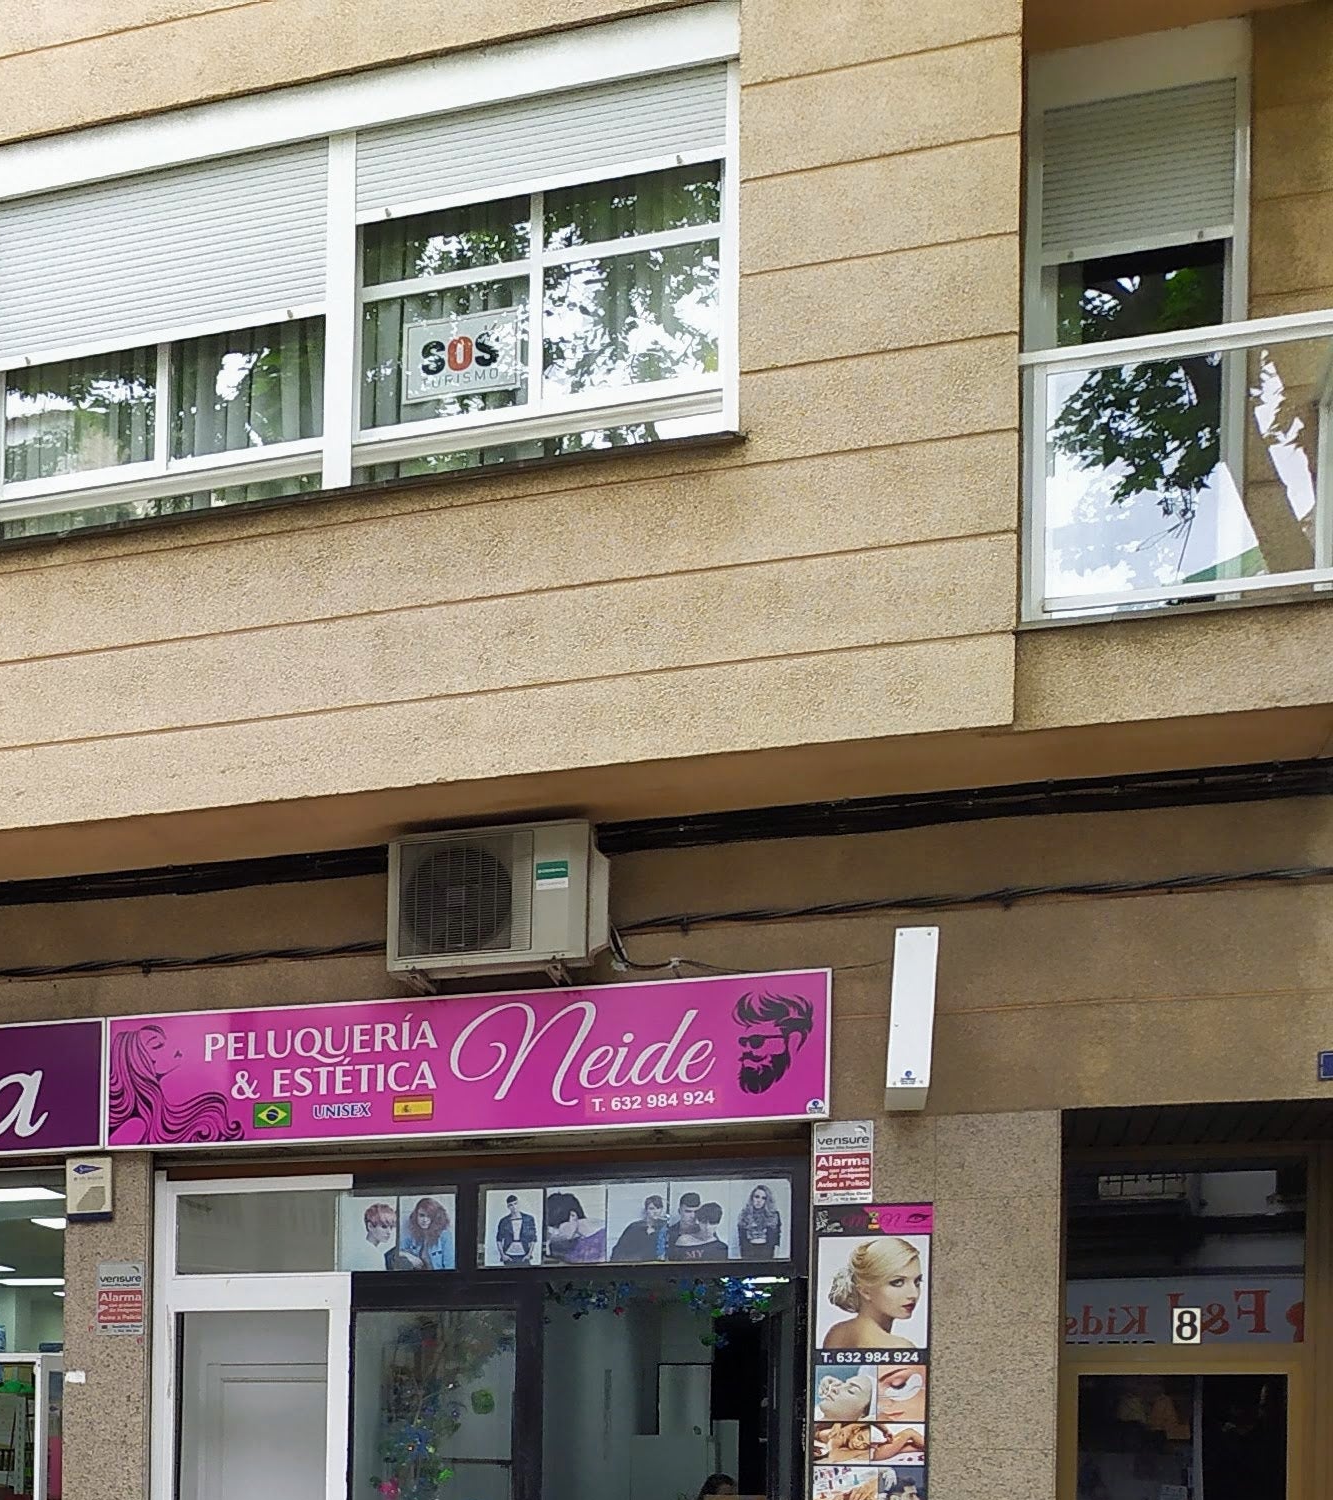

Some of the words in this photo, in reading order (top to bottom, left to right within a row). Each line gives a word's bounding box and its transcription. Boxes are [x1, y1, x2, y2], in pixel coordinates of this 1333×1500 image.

[421, 332, 500, 376] SOS
[204, 1013, 439, 1064] PELUQUERÍA
[449, 1001, 717, 1106] Neide
[230, 1070, 261, 1100] &
[272, 1057, 437, 1098] ESTÉTICA
[312, 1103, 371, 1120] UNISEX
[590, 1098, 607, 1113] T.
[611, 1095, 642, 1111] 632
[646, 1093, 679, 1108] 984
[683, 1090, 716, 1106] 924
[817, 1135, 870, 1146] verisure
[817, 1156, 870, 1168] Alarma
[99, 1292, 142, 1302] Alarma
[1176, 1310, 1198, 1341] 8
[821, 1352, 833, 1363] T.
[836, 1352, 862, 1363] 632
[865, 1352, 891, 1363] 984
[893, 1352, 920, 1363] 924
